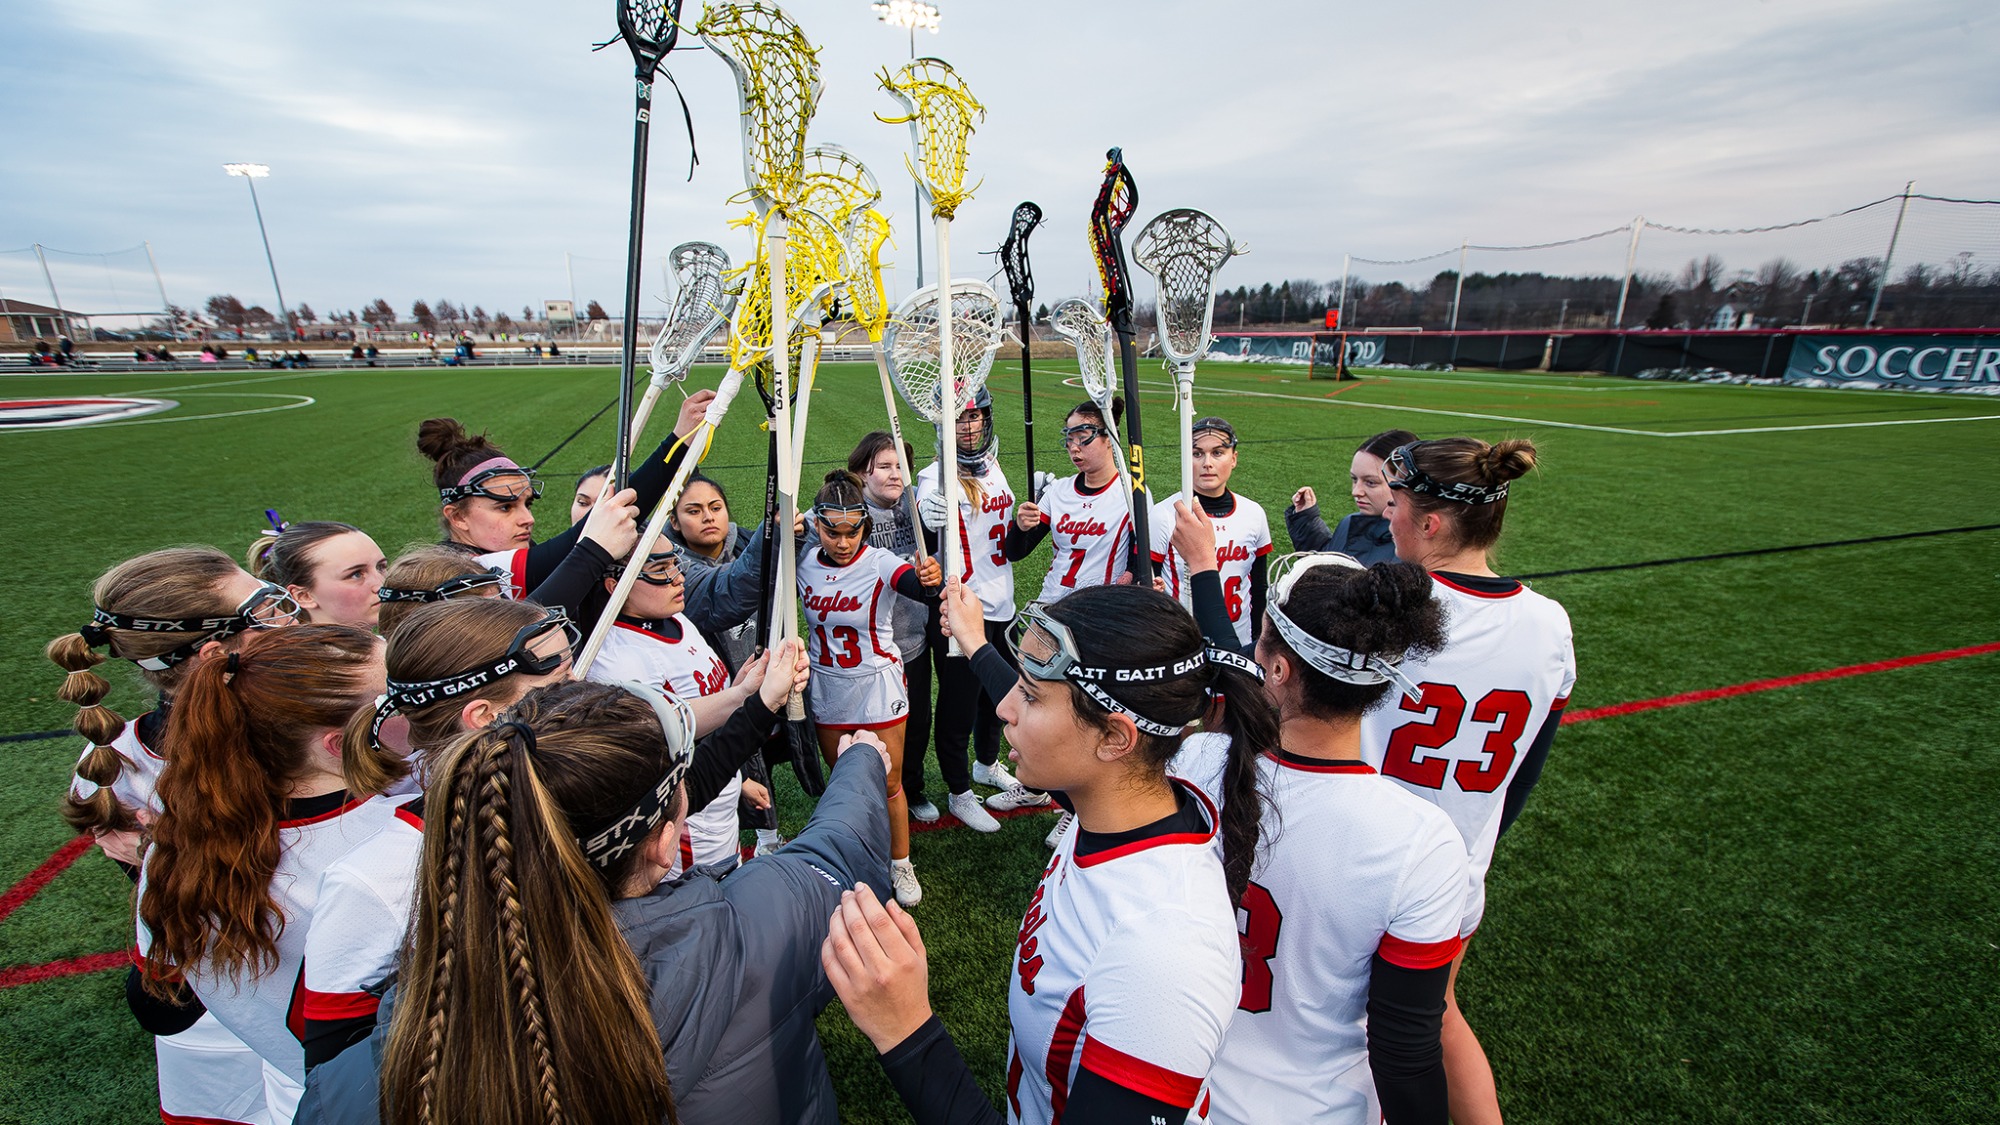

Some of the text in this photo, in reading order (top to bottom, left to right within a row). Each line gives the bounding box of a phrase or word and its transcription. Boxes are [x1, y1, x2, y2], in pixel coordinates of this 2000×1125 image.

[1812, 344, 2000, 382] SOCCER
[774, 369, 783, 410] GAIT
[1129, 444, 1146, 494] STX
[441, 487, 458, 497] STX
[1453, 482, 1488, 495] STX
[765, 475, 775, 539] MAVERIK
[1056, 513, 1108, 545] Eagles
[1215, 540, 1250, 572] gles
[94, 607, 240, 632] STX STX ST
[803, 585, 863, 622] Eagles
[815, 624, 863, 669] 13
[1303, 636, 1349, 663] STX
[443, 672, 488, 696] GAIT
[495, 659, 518, 676] GA
[1116, 666, 1166, 682] GAIT
[1173, 652, 1206, 676] GAIT
[1310, 656, 1358, 682] STX
[1381, 681, 1532, 793] 23
[587, 806, 646, 855] STX
[595, 836, 635, 868] TX
